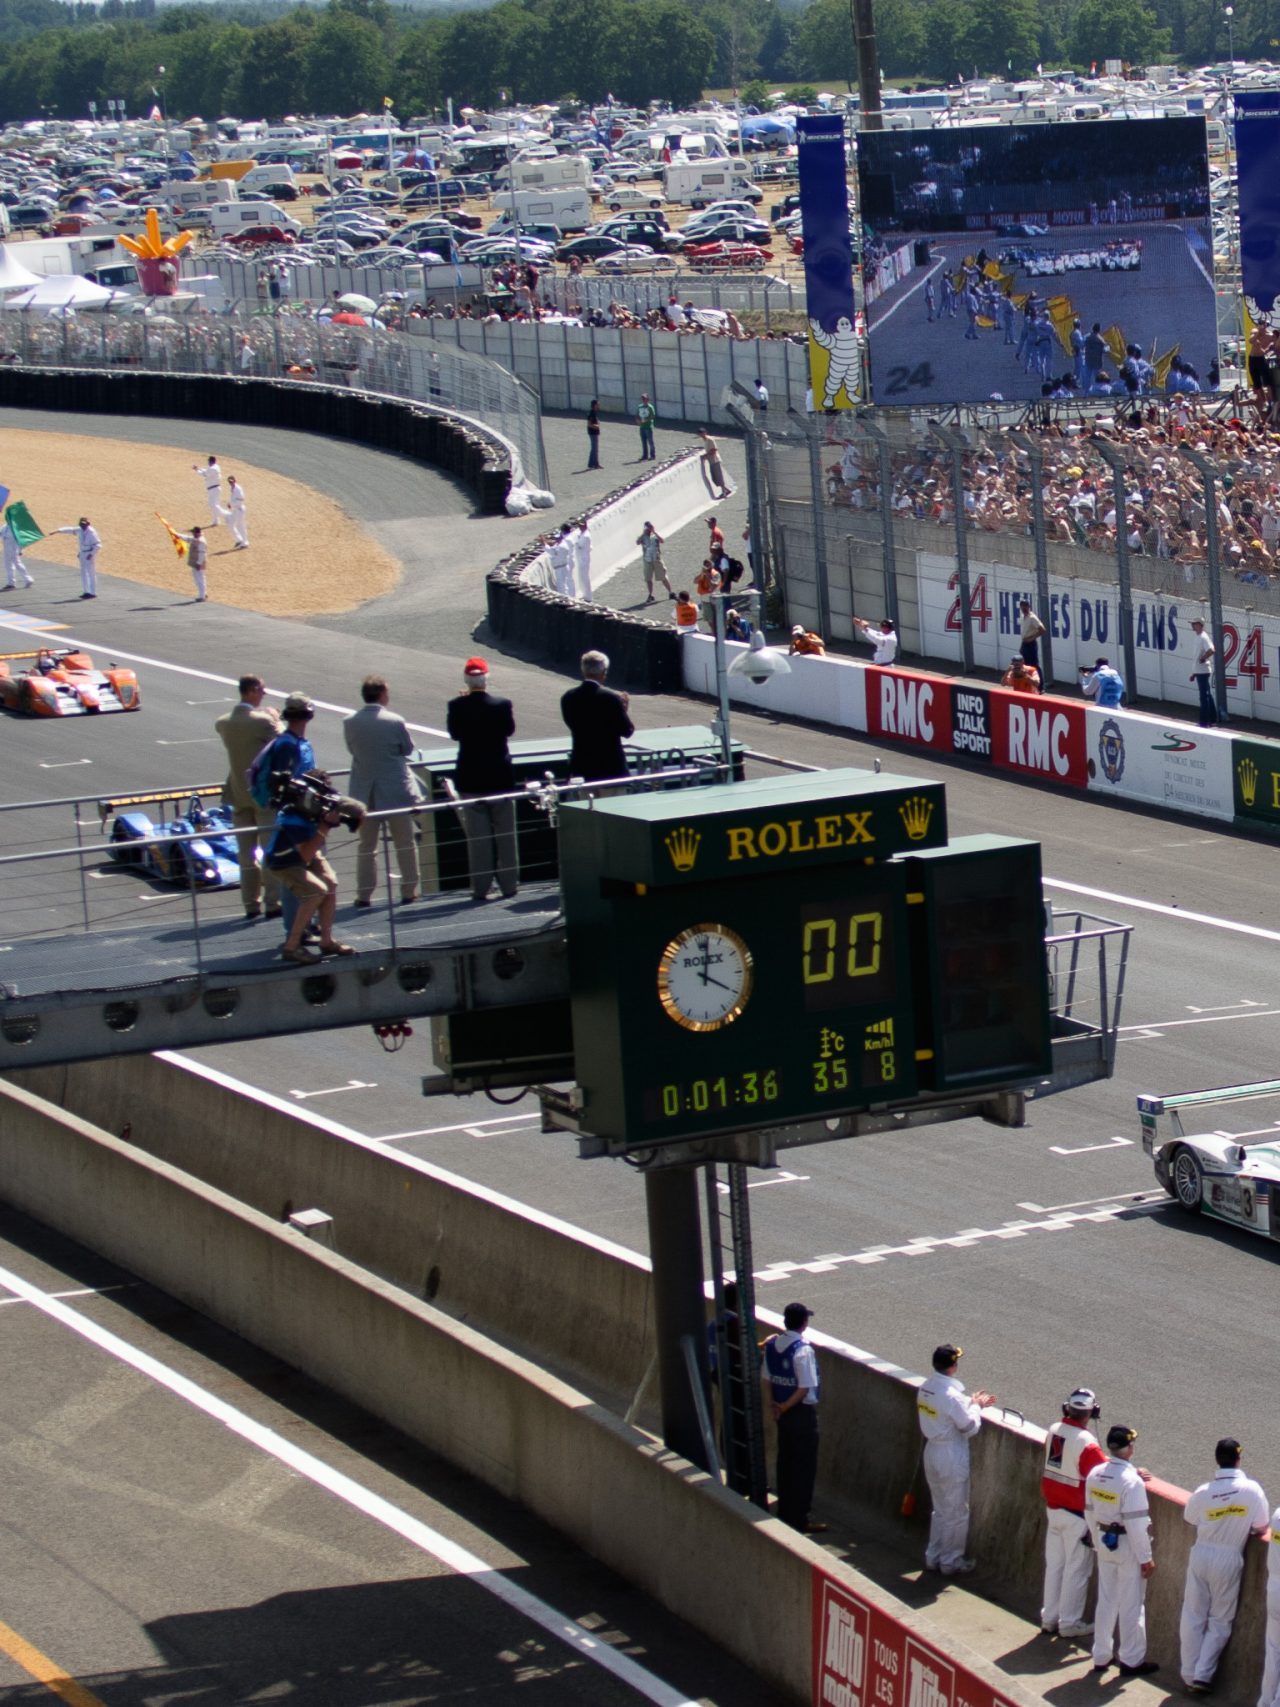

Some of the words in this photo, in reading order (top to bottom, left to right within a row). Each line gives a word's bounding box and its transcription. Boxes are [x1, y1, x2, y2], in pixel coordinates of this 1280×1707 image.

[884, 361, 934, 396] 24
[944, 570, 993, 633] 24
[999, 591, 1071, 640] HEES
[1081, 598, 1108, 644] DU
[1119, 602, 1178, 651] ANS
[1212, 621, 1271, 693] 24
[880, 674, 934, 743] RMC
[956, 693, 984, 714] INFO
[956, 711, 985, 734] TALK
[1008, 703, 1070, 777] RMC
[953, 729, 991, 755] SPORT
[727, 811, 876, 861] ROLEX
[683, 953, 724, 968] ROLEX
[803, 912, 883, 985] 00
[864, 1036, 892, 1050] Km/h
[813, 1058, 848, 1093] 35
[880, 1051, 896, 1081] 8
[1243, 1188, 1254, 1218] 3
[874, 1638, 899, 1676] TOUS
[875, 1673, 894, 1706] LES
